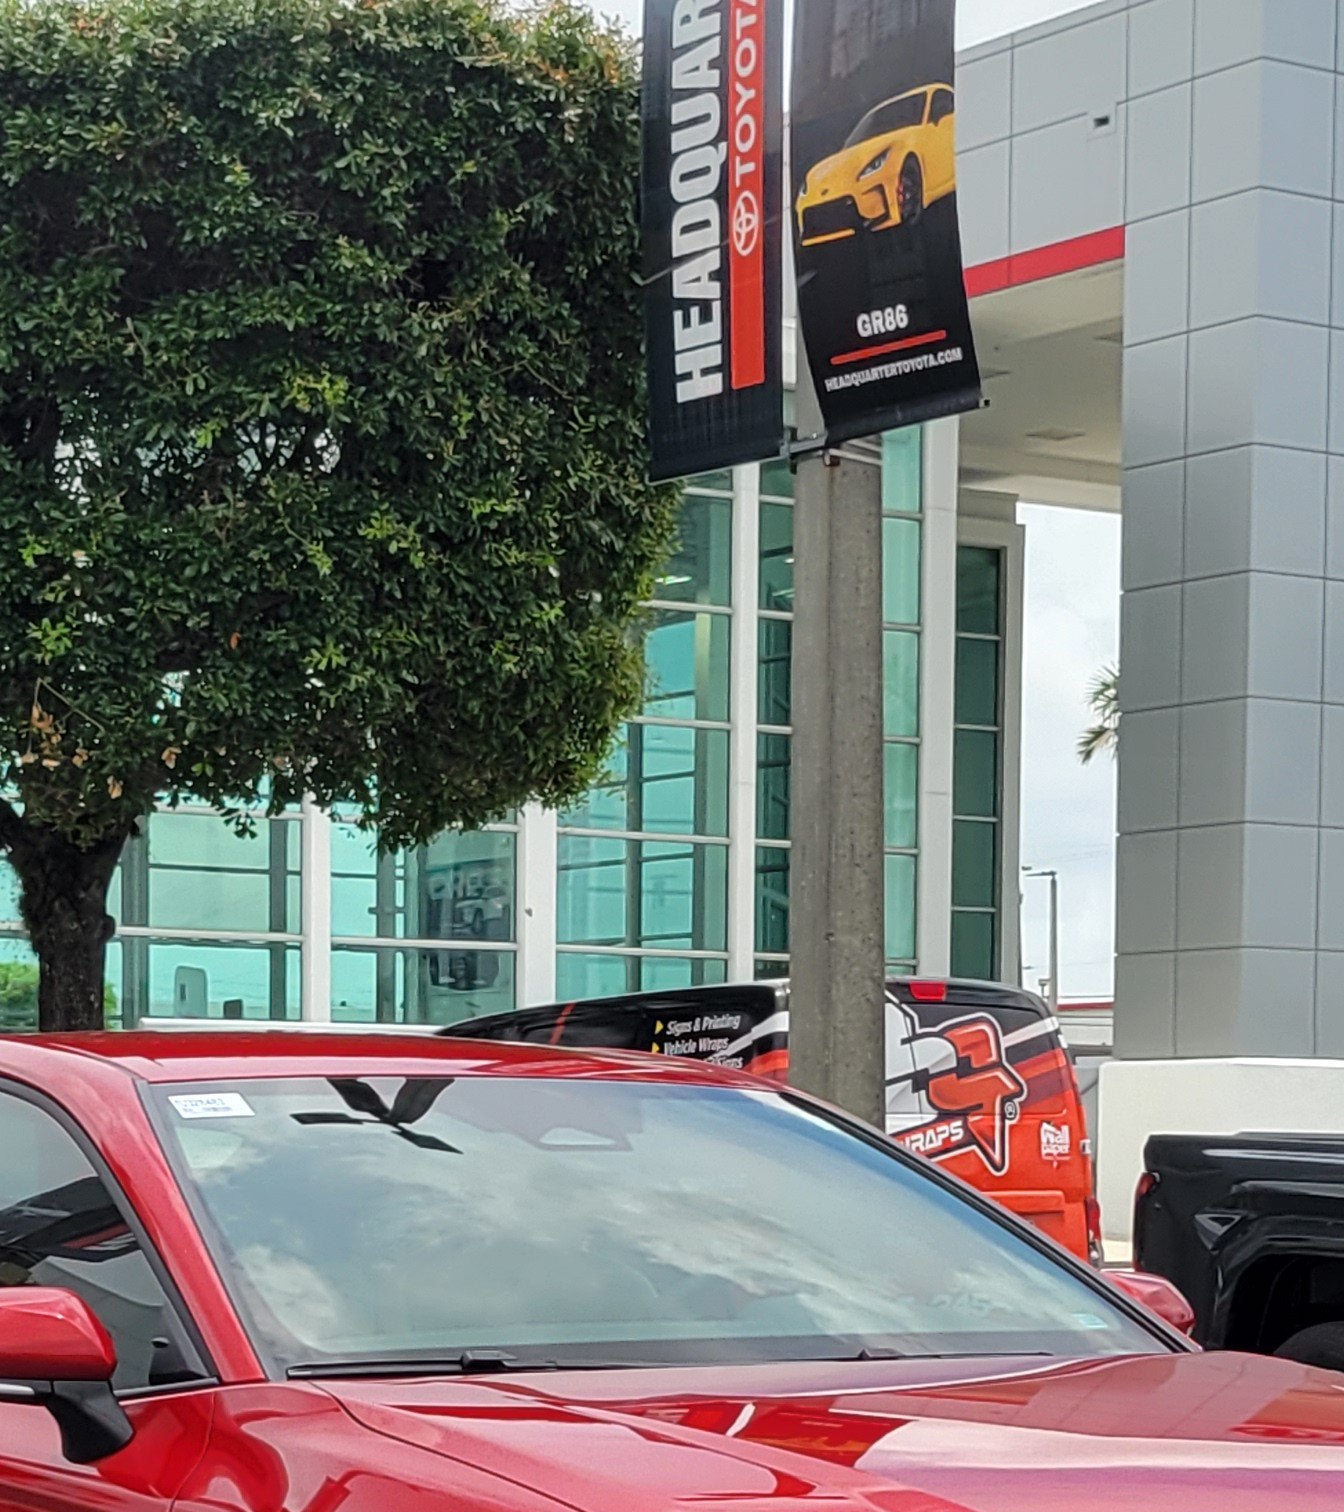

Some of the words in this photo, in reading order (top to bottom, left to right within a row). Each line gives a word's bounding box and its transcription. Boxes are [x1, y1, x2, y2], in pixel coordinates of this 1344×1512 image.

[735, 0, 758, 188] TOYOT
[856, 304, 909, 338] GR86
[824, 347, 963, 393] HEADQUARTERTOYOTA.COM
[702, 1013, 741, 1031] Printing
[663, 1039, 697, 1055] Vehicle
[698, 1037, 729, 1052] Wraps
